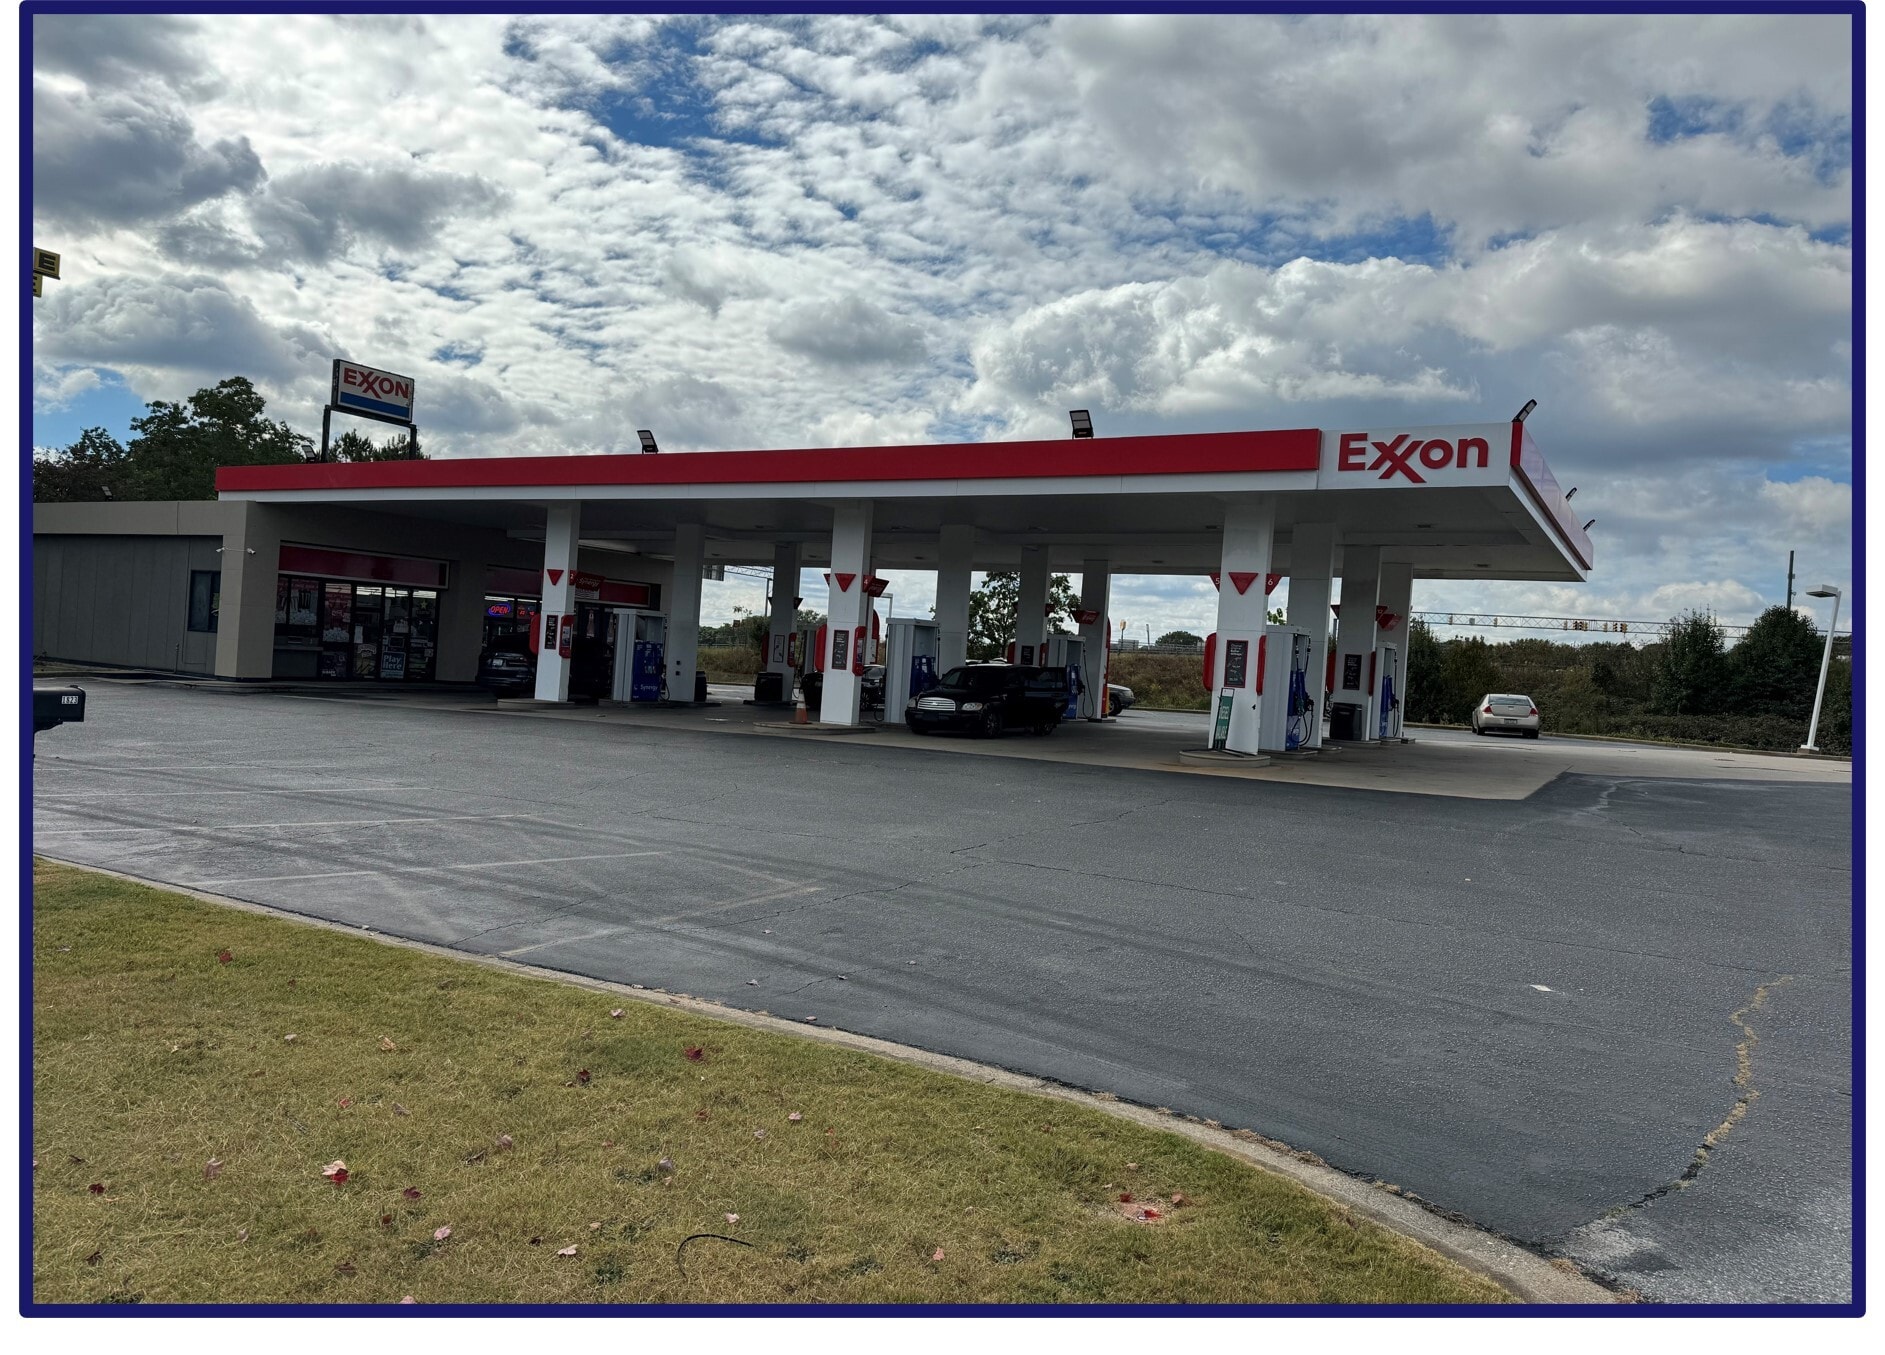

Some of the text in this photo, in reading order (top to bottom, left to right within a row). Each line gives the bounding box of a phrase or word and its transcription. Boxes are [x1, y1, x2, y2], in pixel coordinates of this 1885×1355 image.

[343, 367, 409, 399] EXXON
[1338, 433, 1489, 484] Exxon
[1215, 577, 1220, 585] 5
[1267, 578, 1274, 586] 6
[490, 604, 509, 614] OPEN
[383, 655, 402, 663] Play
[382, 661, 402, 670] Here
[640, 684, 658, 692] Synergy
